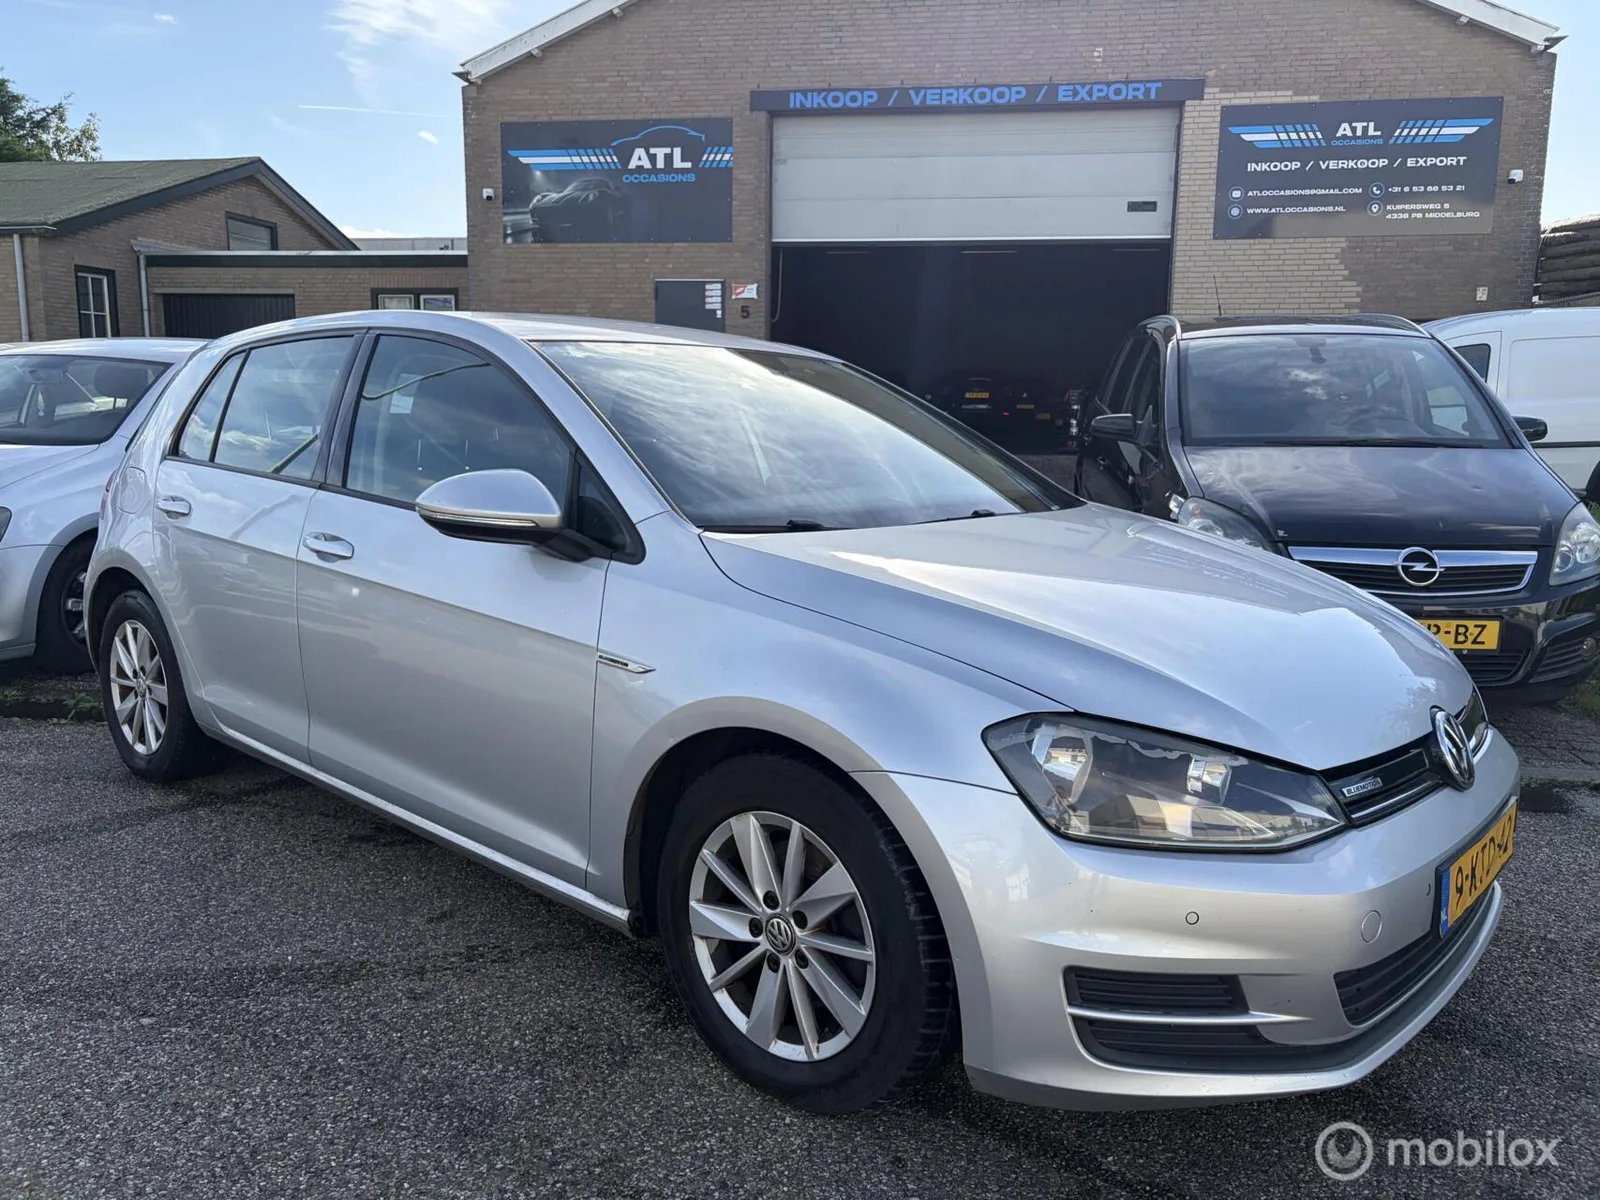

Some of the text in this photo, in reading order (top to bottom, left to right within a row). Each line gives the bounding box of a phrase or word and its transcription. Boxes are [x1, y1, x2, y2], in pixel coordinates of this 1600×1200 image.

[789, 82, 1162, 109] INKOOP / VERKOOP / EXPORT
[1335, 121, 1382, 137] ATL
[1331, 138, 1384, 146] OCCASIONS
[627, 147, 692, 169] ATL
[1247, 156, 1467, 172] INKOOP / VERKOOP / EXPORT
[622, 173, 696, 183] OCCASIONS
[1246, 205, 1347, 214] WWW.ATLOCCASIONS.NL
[740, 305, 750, 319] 5
